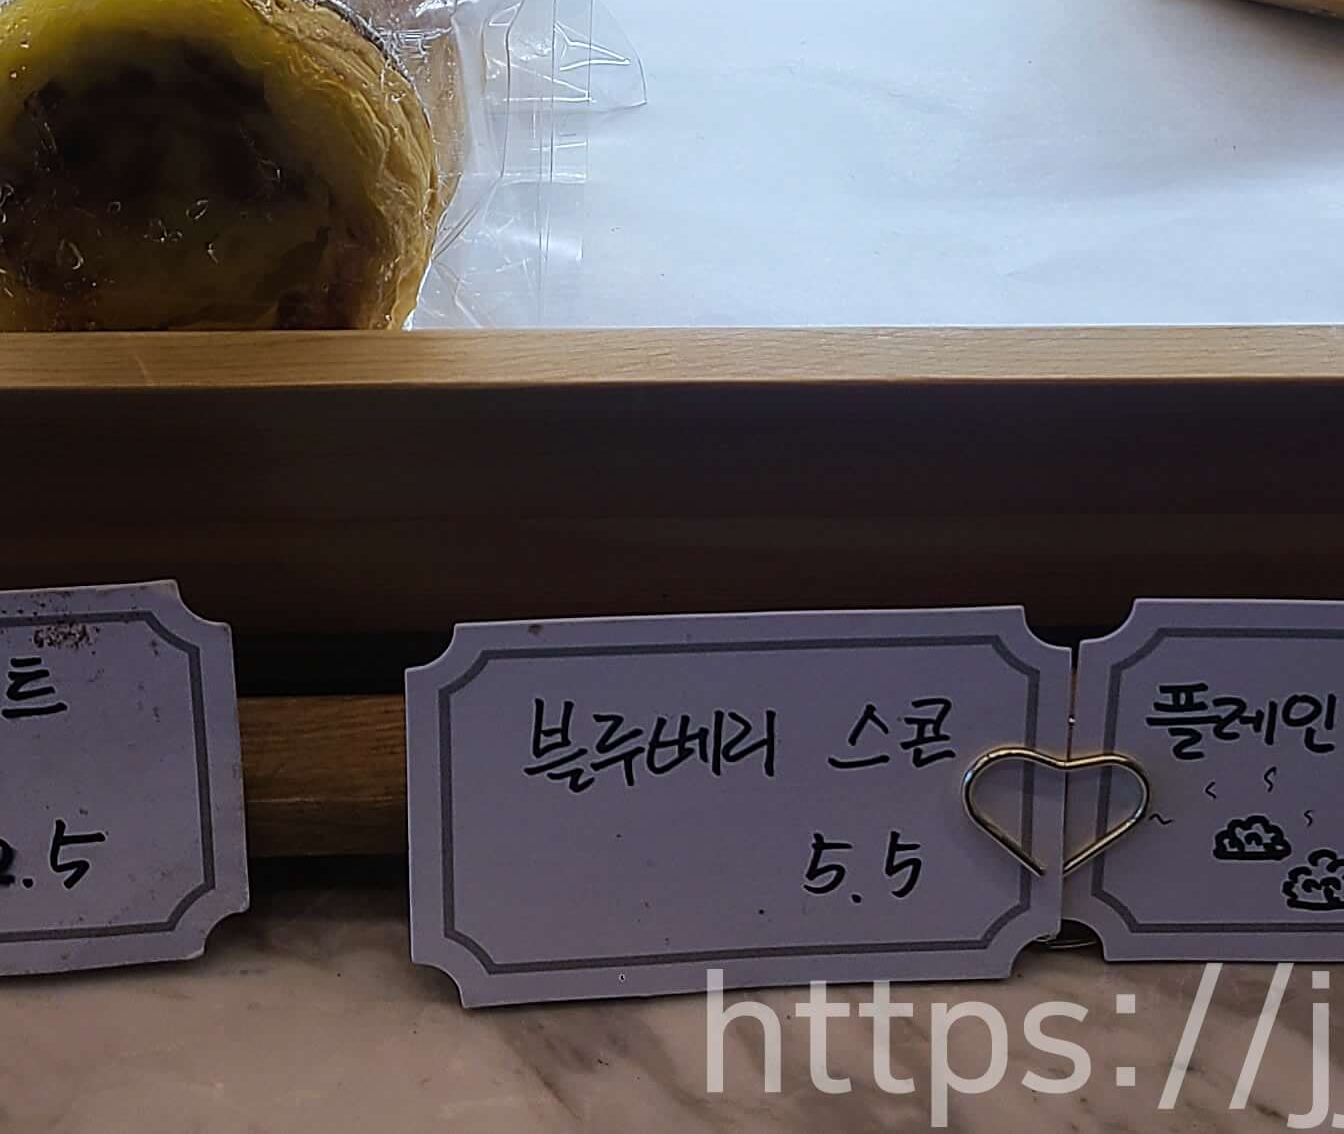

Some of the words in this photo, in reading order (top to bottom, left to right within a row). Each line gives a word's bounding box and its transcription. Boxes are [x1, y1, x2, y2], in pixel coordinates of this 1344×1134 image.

[523, 697, 777, 795] 블루베리
[827, 696, 957, 771] 스콘
[1145, 680, 1340, 762] 플레인
[801, 830, 923, 905] 5.5
